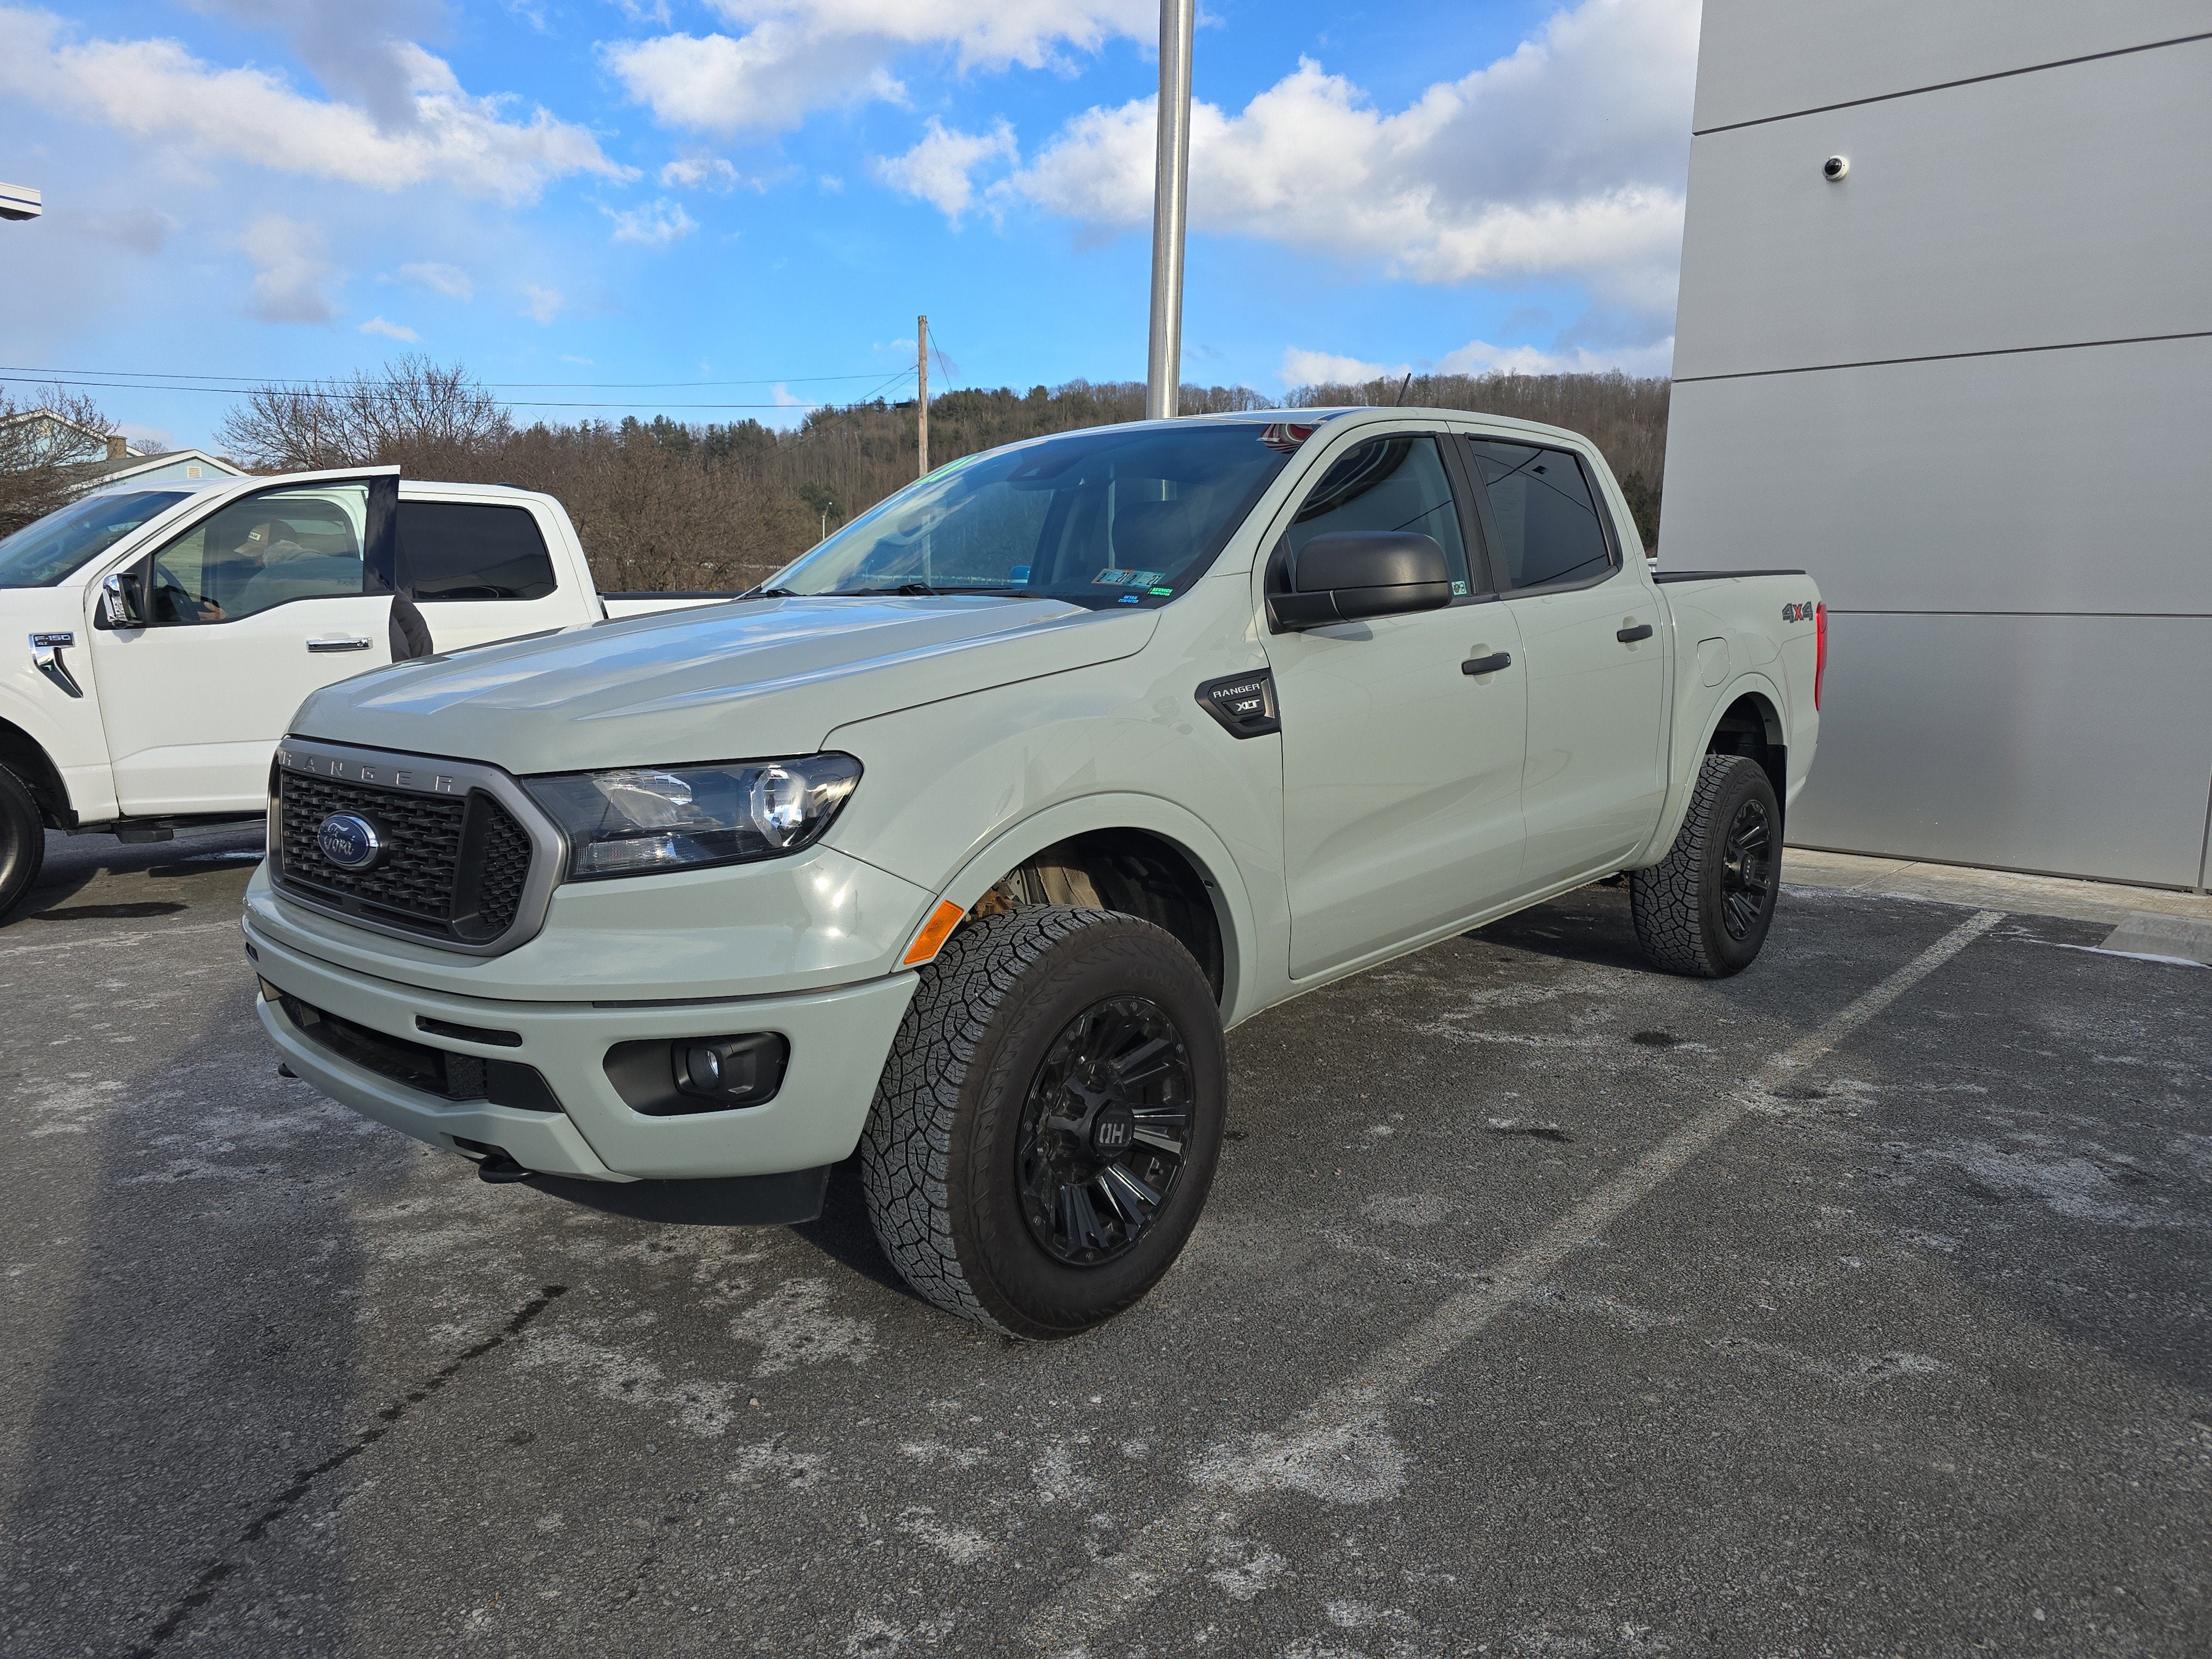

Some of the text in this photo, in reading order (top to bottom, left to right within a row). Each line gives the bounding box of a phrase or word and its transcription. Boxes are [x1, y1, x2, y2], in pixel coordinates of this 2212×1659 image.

[1096, 573, 1107, 582] 2
[1115, 572, 1129, 583] 27
[1146, 575, 1161, 586] 27
[1213, 683, 1261, 698] RANGER
[1235, 699, 1260, 712] XLT
[281, 750, 454, 793] RANGER
[324, 822, 356, 856] Ford
